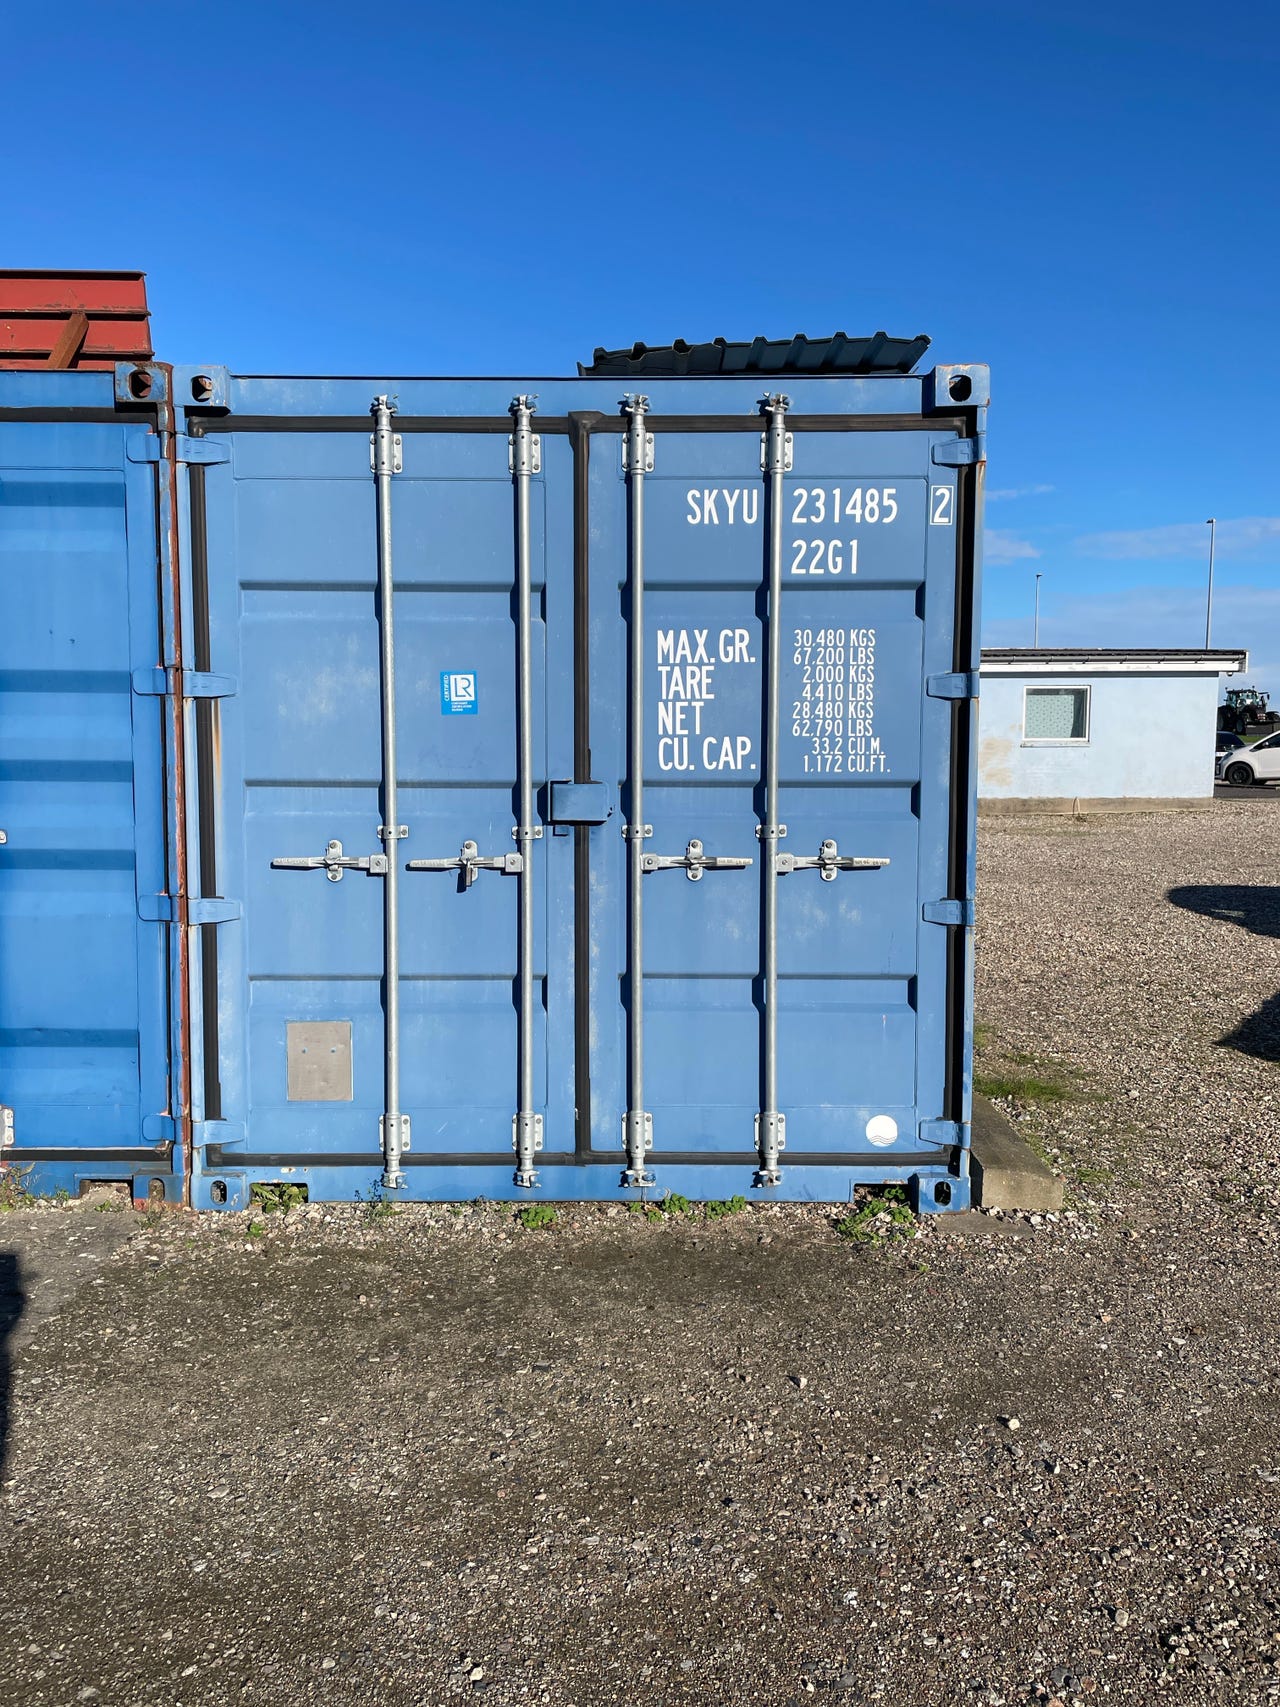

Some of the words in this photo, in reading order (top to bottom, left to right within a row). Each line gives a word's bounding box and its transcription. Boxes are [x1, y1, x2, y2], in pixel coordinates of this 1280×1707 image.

[686, 488, 758, 525] SKYU
[791, 487, 898, 524] 231485
[933, 487, 951, 524] 2
[790, 539, 859, 575] 22G1
[849, 628, 876, 648] KGS
[849, 647, 876, 666] LBS
[657, 665, 715, 700] TARE
[848, 665, 875, 684] KGS
[848, 683, 874, 702] LBS
[657, 701, 705, 736] NET
[848, 701, 874, 720] KGS
[847, 719, 873, 738] LBS
[658, 736, 695, 771] CU.
[702, 735, 757, 771] CAP.
[811, 736, 843, 756] 33.2
